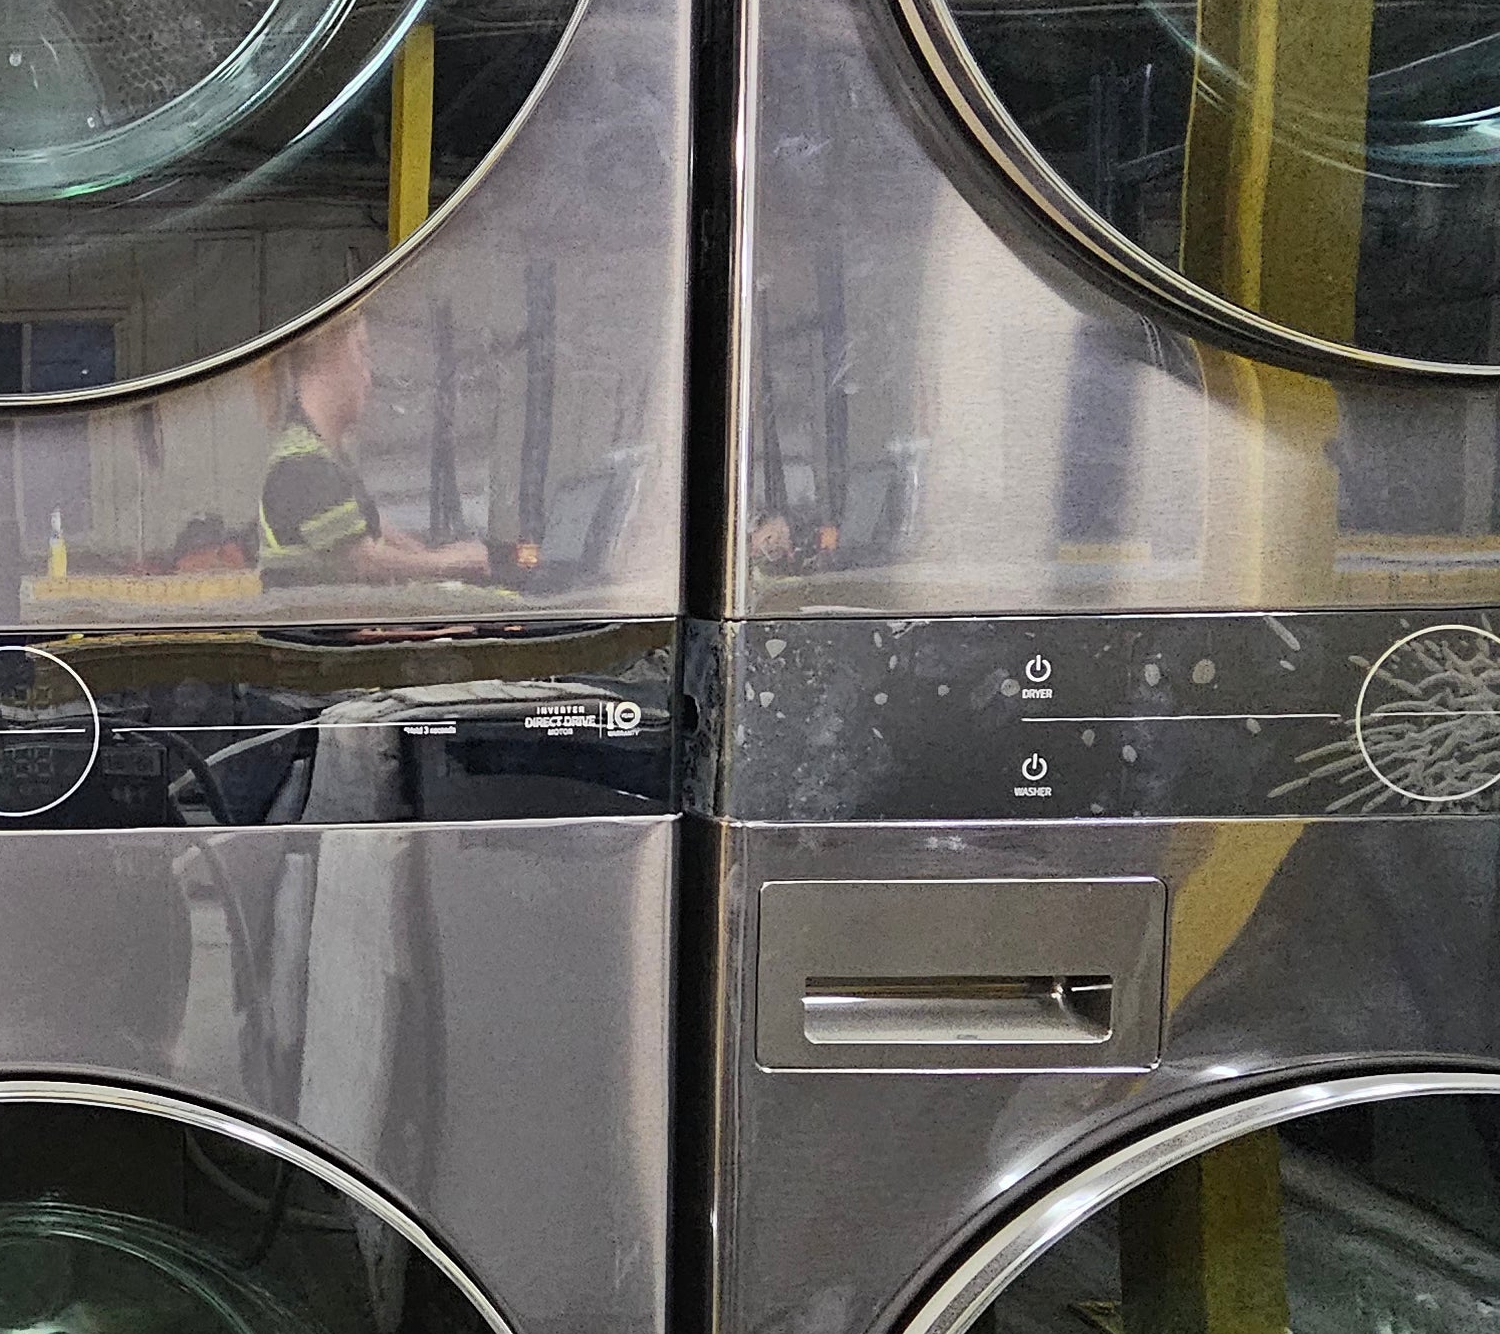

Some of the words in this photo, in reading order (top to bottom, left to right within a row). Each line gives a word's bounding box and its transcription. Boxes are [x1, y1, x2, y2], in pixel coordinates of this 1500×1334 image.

[1022, 689, 1053, 698] DRYER
[536, 706, 585, 714] INVERTER
[606, 701, 641, 729] 10
[524, 717, 562, 728] DIRECT
[562, 715, 597, 727] DRIVE
[1014, 787, 1052, 796] WASHER
